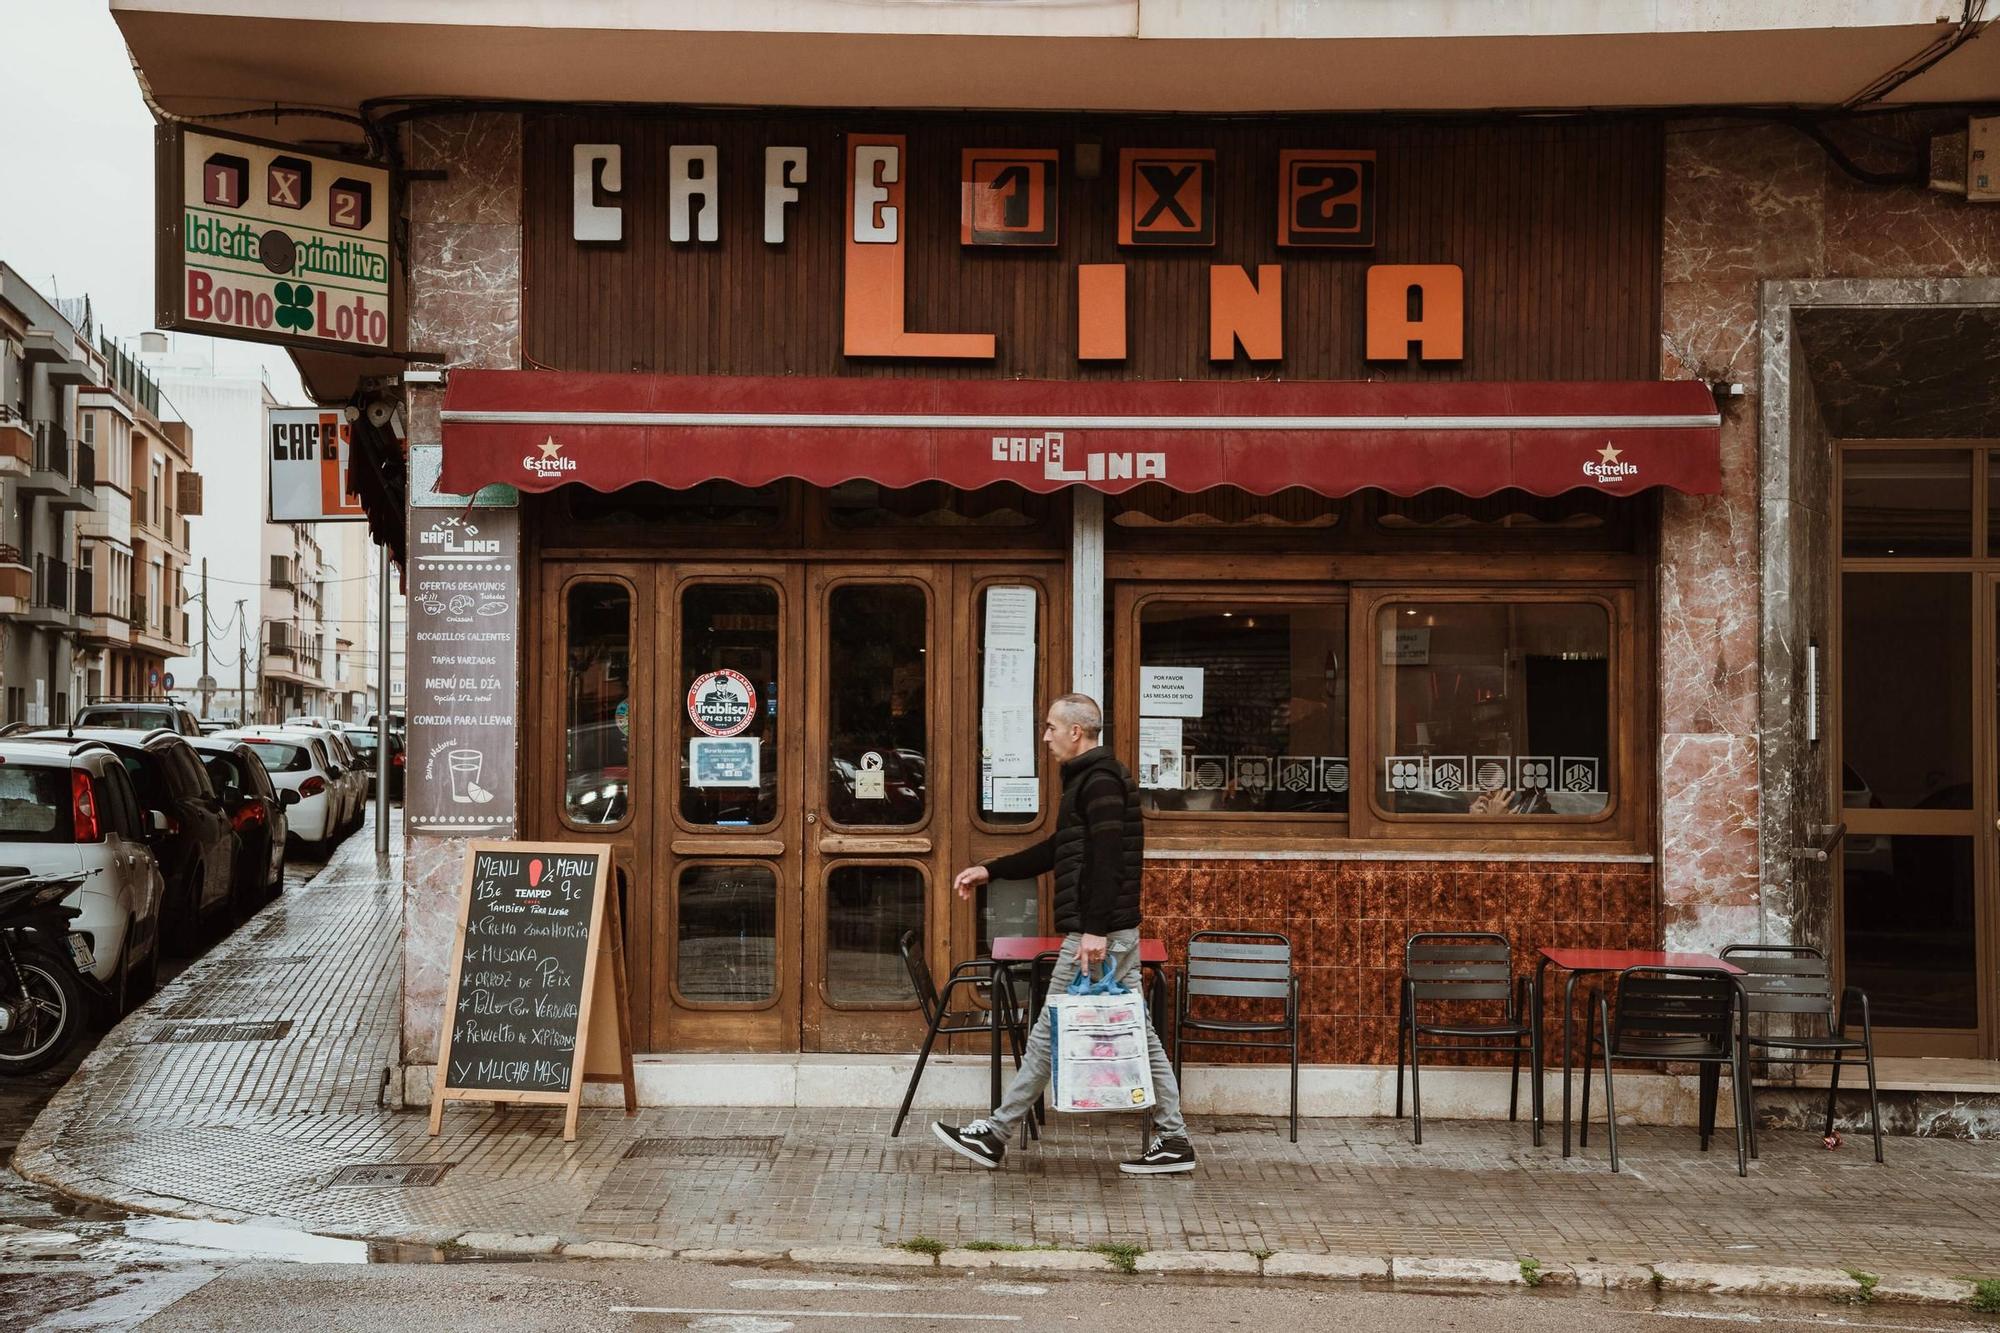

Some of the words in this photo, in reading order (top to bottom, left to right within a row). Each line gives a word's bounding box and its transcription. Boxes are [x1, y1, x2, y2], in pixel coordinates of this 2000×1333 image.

[215, 171, 230, 203] 1
[271, 170, 299, 205] X
[335, 193, 356, 226] 2
[573, 144, 900, 244] CAFE
[1136, 165, 1198, 228] X
[1296, 166, 1359, 228] 2
[843, 133, 1465, 360] LINA
[293, 235, 387, 284] primitiva
[188, 269, 274, 329] Bono
[316, 290, 387, 345] Loto
[272, 423, 337, 460] CAFE
[992, 437, 1061, 463] CAFE
[523, 455, 577, 471] Estrella
[1044, 432, 1167, 481] LINA
[537, 469, 561, 477] Damm
[1582, 460, 1638, 476] Estrella
[1598, 475, 1623, 483] Damm
[444, 529, 500, 552] LINA
[420, 581, 456, 591] OFERTAS
[458, 582, 506, 591] DESAYUNOS
[416, 632, 465, 641] BOCADILLOS
[467, 632, 511, 641] CALIENTES
[431, 656, 455, 665] TAPAS
[457, 656, 497, 665] VARIADAS
[425, 674, 457, 689] MENÚ
[459, 678, 478, 689] DEL
[480, 675, 502, 690] DÍA
[696, 702, 747, 715] Trablisa
[413, 715, 452, 726] COMIDA
[454, 715, 478, 726] PARA
[479, 715, 513, 726] LLEVAR
[476, 856, 520, 879] MENU
[556, 858, 595, 877] MENU
[514, 888, 552, 898] TEMPLO
[482, 945, 538, 964] MUSAKA
[475, 970, 513, 988] ARROZ
[518, 975, 533, 990] DE
[534, 993, 578, 1019] VERDURA
[454, 1060, 473, 1084] Y
[477, 1059, 531, 1084] MUCHO
